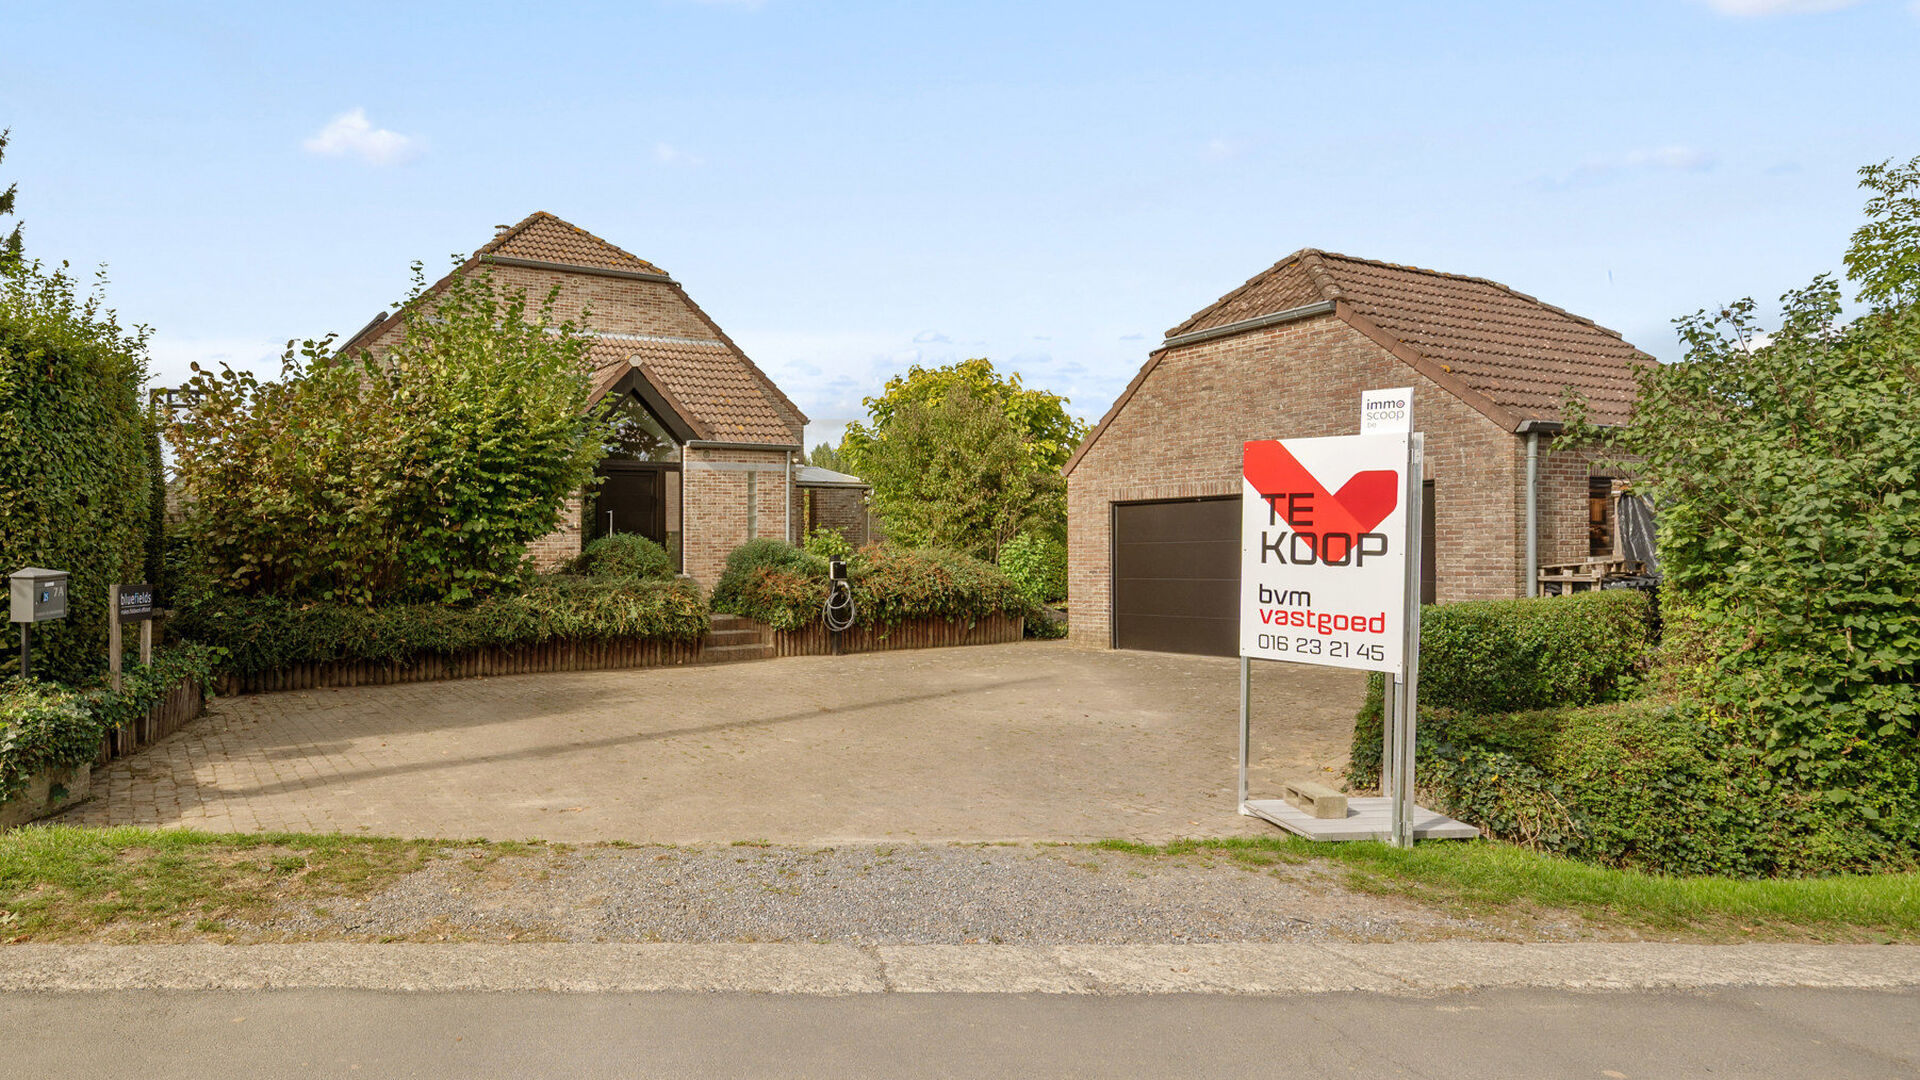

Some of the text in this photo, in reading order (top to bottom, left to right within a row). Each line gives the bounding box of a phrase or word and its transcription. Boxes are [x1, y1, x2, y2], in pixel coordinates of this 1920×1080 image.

[1366, 398, 1406, 410] immo
[1366, 409, 1405, 421] scoop
[1260, 492, 1315, 526] TE
[1261, 531, 1388, 567] KOOP
[120, 592, 151, 606] bluefields
[1258, 583, 1312, 607] bvm
[1258, 608, 1386, 636] vastgoed
[1257, 633, 1385, 663] 016 23 21 45
